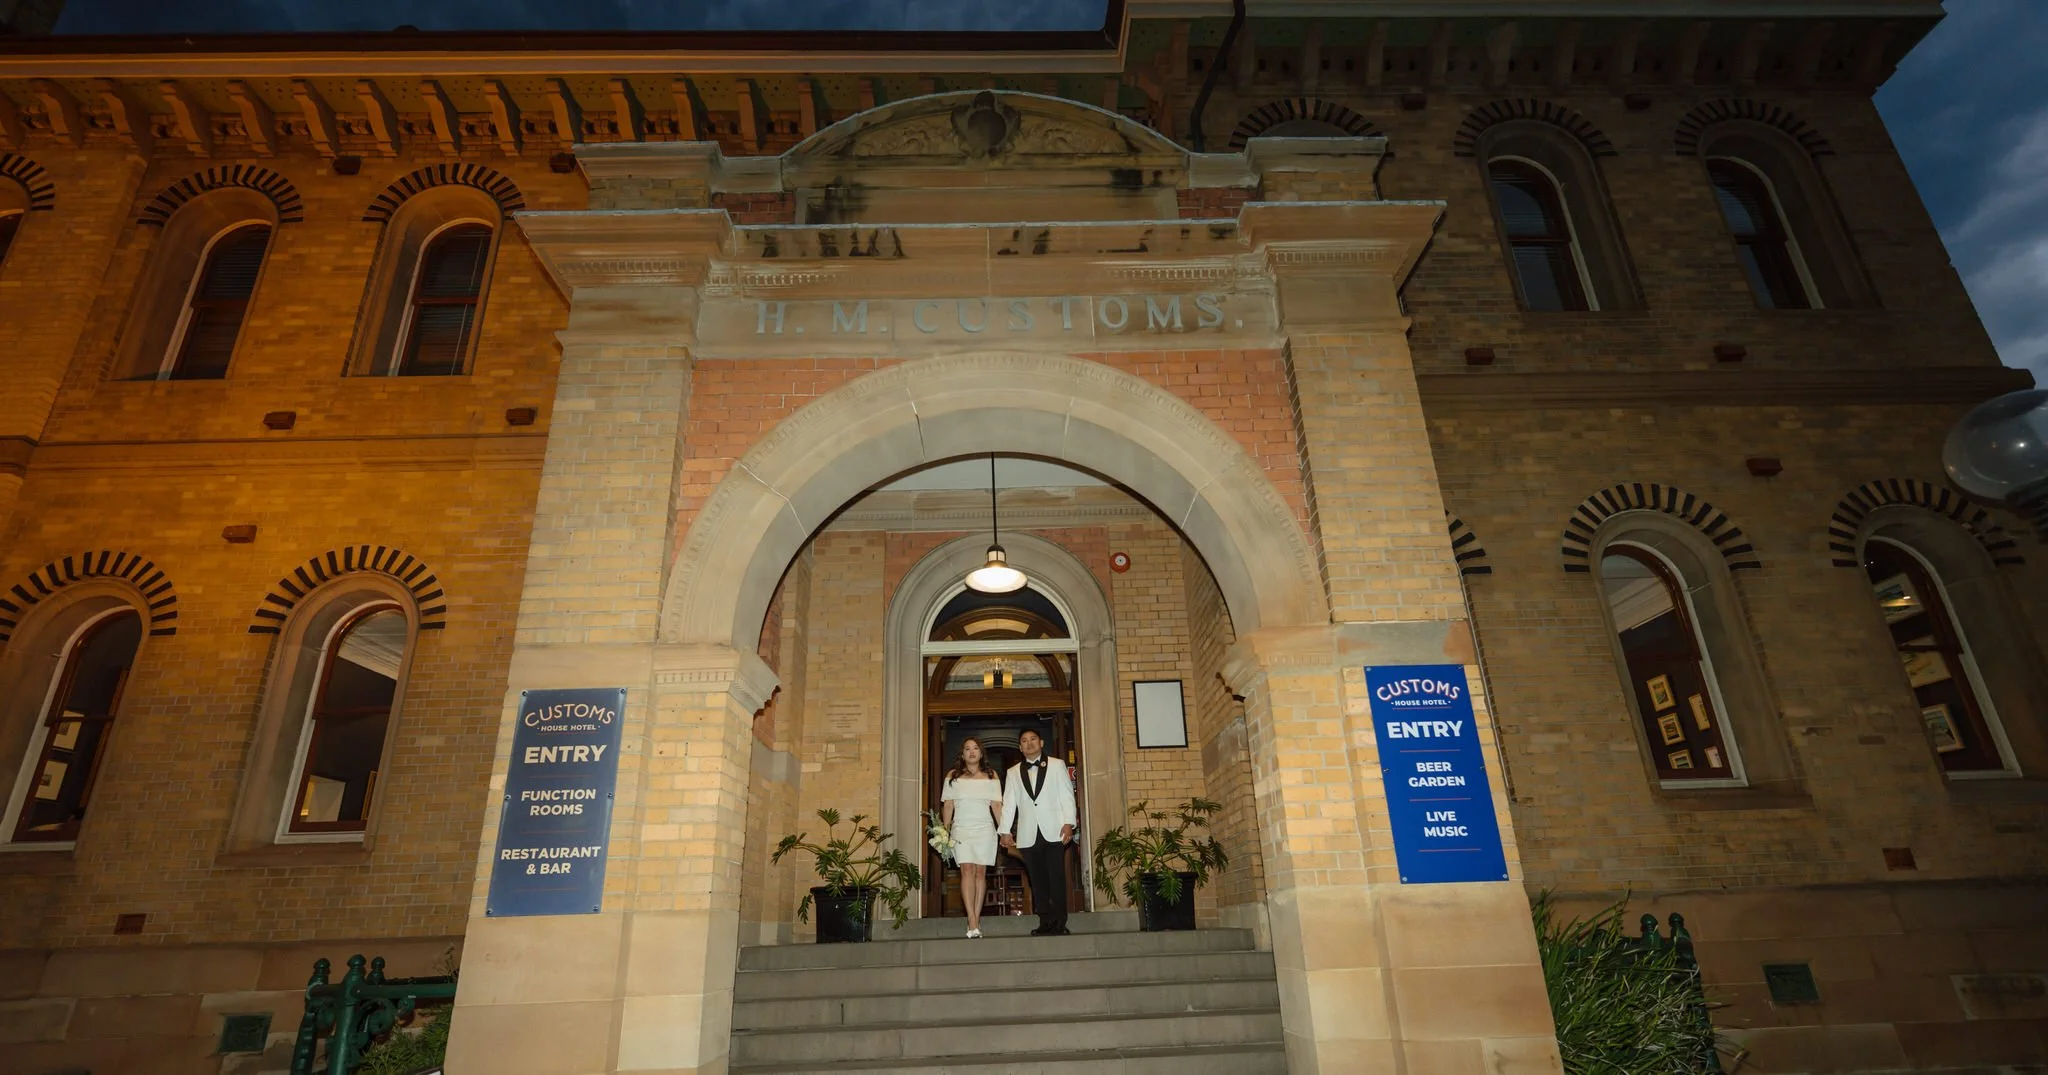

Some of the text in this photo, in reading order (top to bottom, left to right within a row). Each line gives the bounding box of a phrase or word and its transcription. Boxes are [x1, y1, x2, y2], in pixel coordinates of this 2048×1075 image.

[754, 293, 1245, 335] H. M. CUSTOMS.
[1376, 678, 1461, 701] CUSTOMS
[525, 703, 615, 727] CUSTOMS
[1386, 720, 1463, 739] ENTRY
[524, 744, 607, 764] ENTRY
[1416, 762, 1452, 772] BEER
[1408, 776, 1466, 787] GARDEN
[521, 788, 596, 801] FUNCTION
[529, 804, 583, 816] ROOMS
[1426, 811, 1457, 822] LIVE
[1424, 826, 1468, 837] MUSIC
[501, 846, 601, 860] RESTAURANT
[526, 862, 571, 875] & BAR
